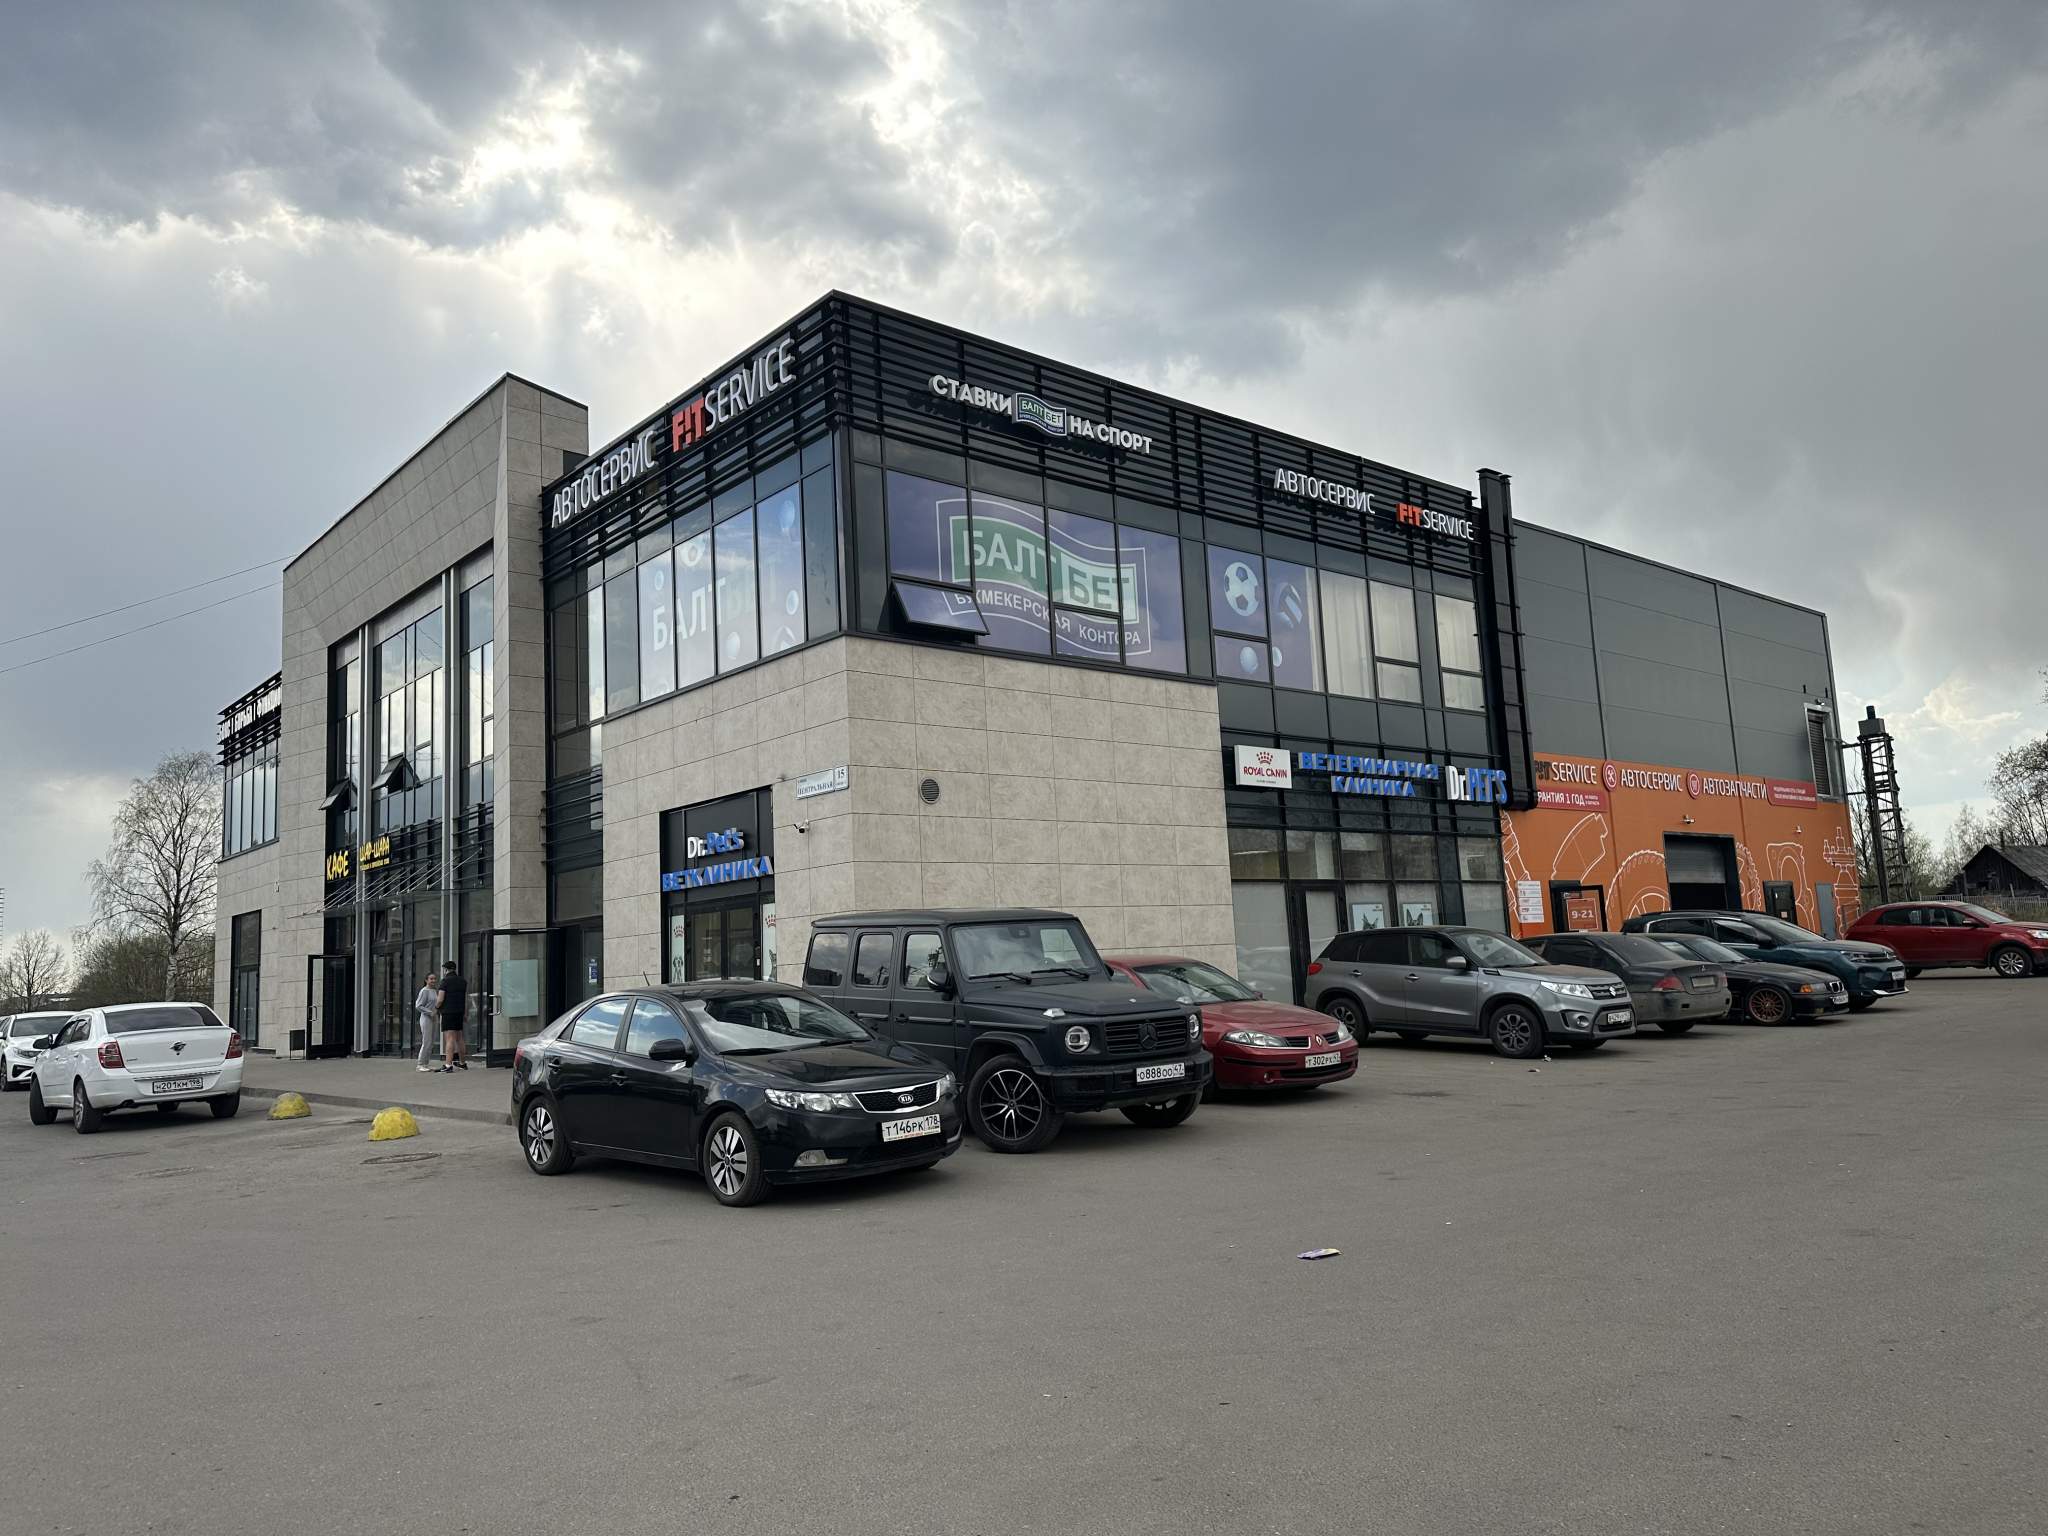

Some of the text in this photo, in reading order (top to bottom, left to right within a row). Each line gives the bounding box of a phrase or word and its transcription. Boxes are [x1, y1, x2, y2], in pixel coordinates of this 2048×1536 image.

[929, 374, 1012, 415] СТАВКИ
[1067, 415, 1095, 439] НА
[1097, 423, 1153, 454] СПОРТ
[551, 430, 659, 529] АВТОСЕРВИС
[1274, 468, 1376, 515] АВТОСЕРВИС
[1243, 766, 1288, 779] ROYAL CANIN
[1298, 752, 1439, 780] ВЕТЕРИНАРНАЯ
[1552, 762, 1598, 785] SERVICE
[1331, 775, 1417, 798] КЛИНИКА
[1621, 768, 1684, 793] АВТОСЕРВИС
[1703, 777, 1768, 800] АВТОЗАПЧАСТИ
[1571, 793, 1586, 807] ГОД
[326, 849, 349, 881] КАФЕ
[662, 855, 774, 892] ВЕТКЛИНИКА
